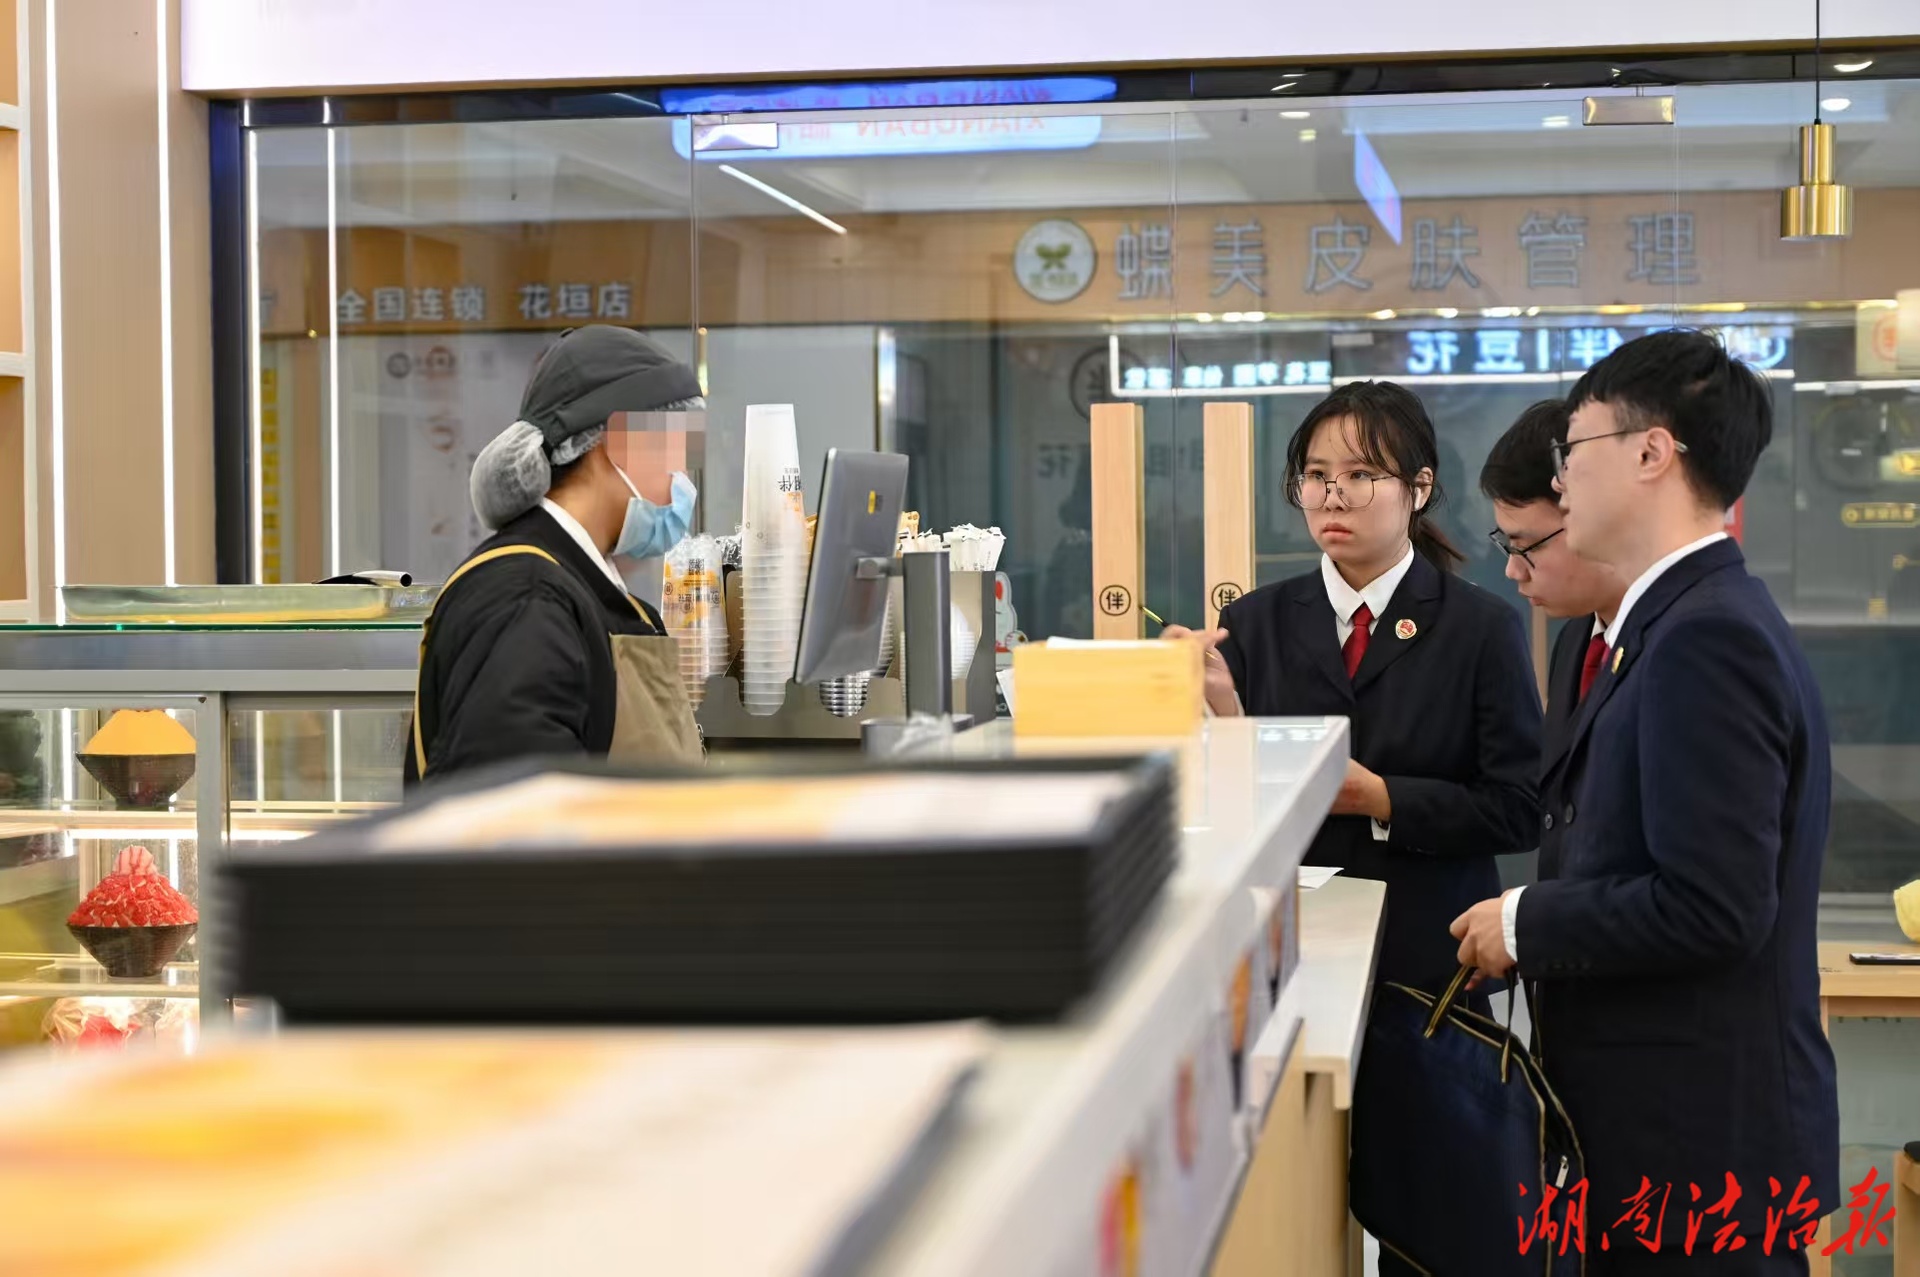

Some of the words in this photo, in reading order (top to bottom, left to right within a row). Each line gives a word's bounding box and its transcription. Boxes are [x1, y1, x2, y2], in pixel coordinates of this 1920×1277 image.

[1114, 211, 1700, 299] 蝶美皮肤管理
[337, 286, 486, 323] 全国连锁
[519, 283, 632, 319] 花垣店
[1105, 591, 1124, 610] 伴
